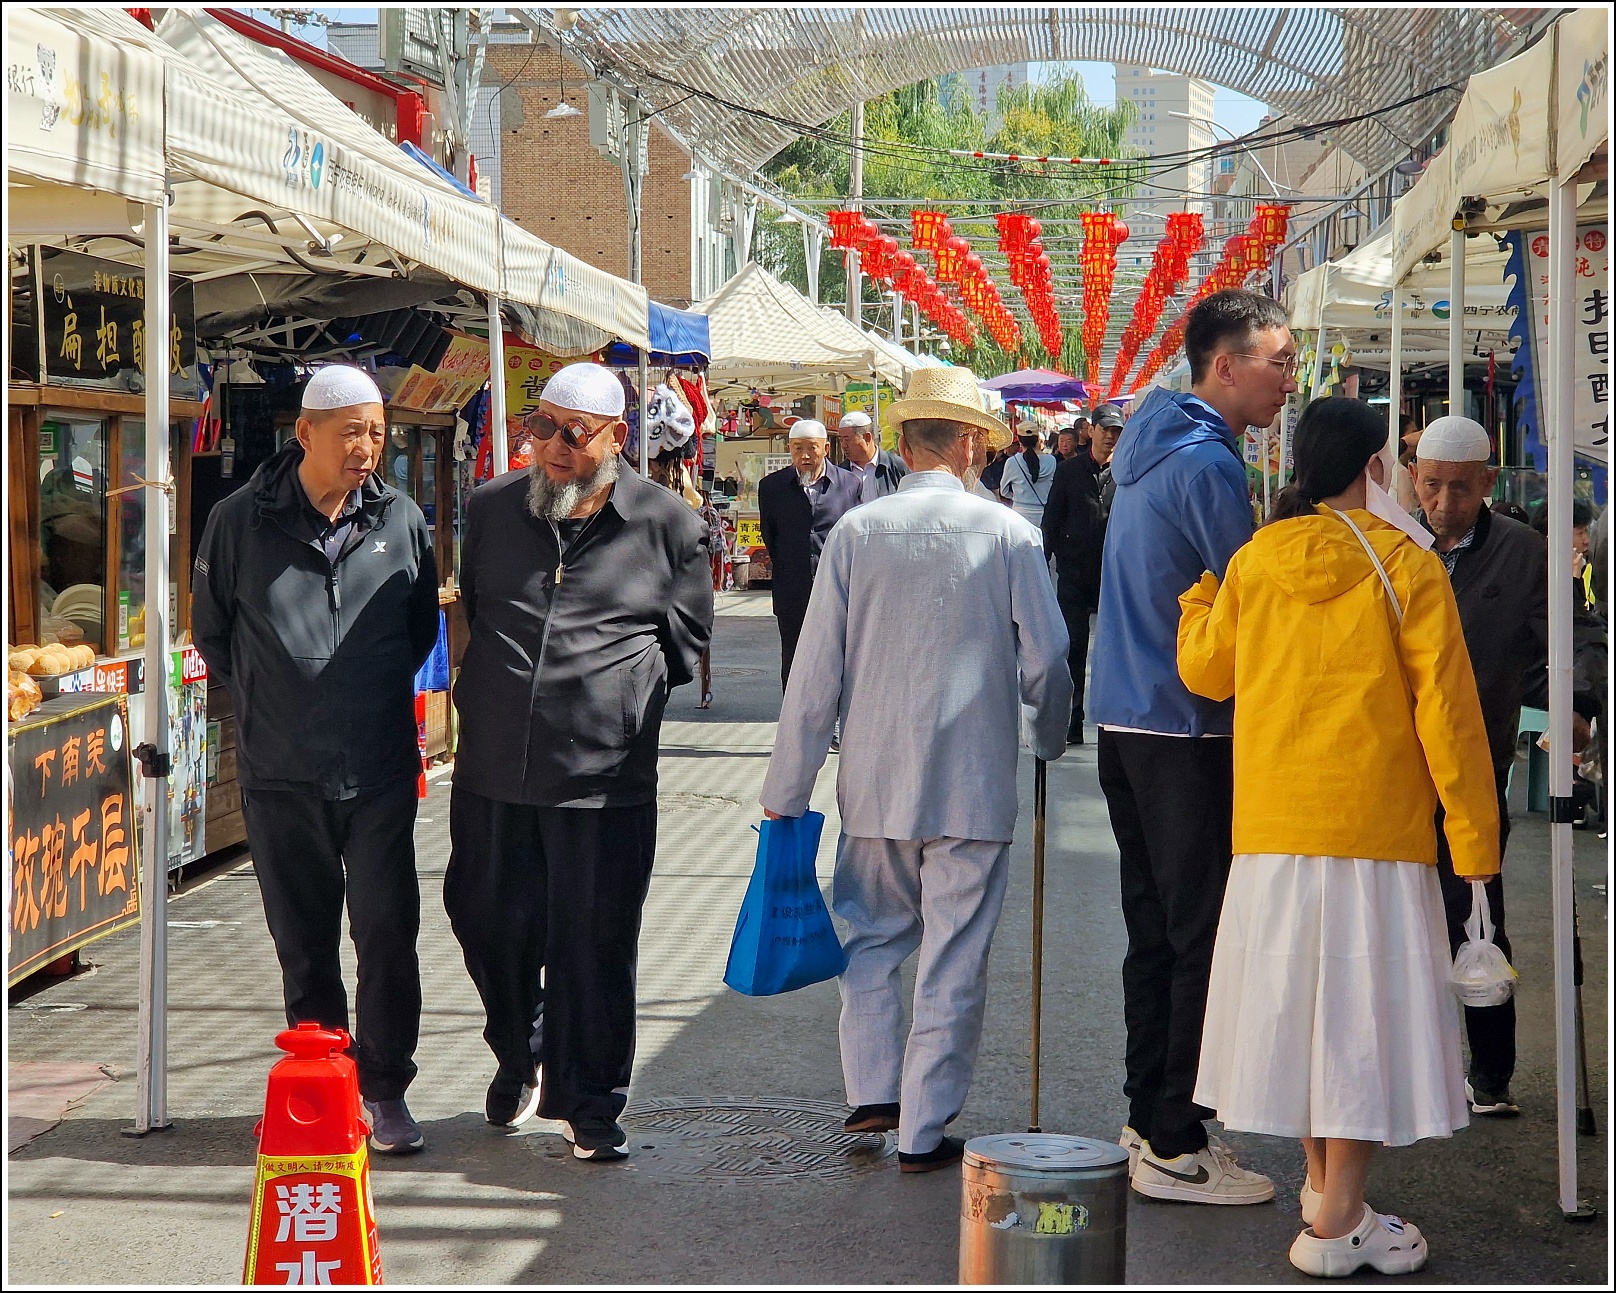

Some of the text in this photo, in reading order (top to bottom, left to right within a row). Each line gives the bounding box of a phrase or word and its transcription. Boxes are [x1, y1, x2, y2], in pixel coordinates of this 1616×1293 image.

[35, 728, 106, 798] 下南关
[14, 793, 129, 935] 玫瑰千层
[264, 1161, 309, 1172] 做文明人
